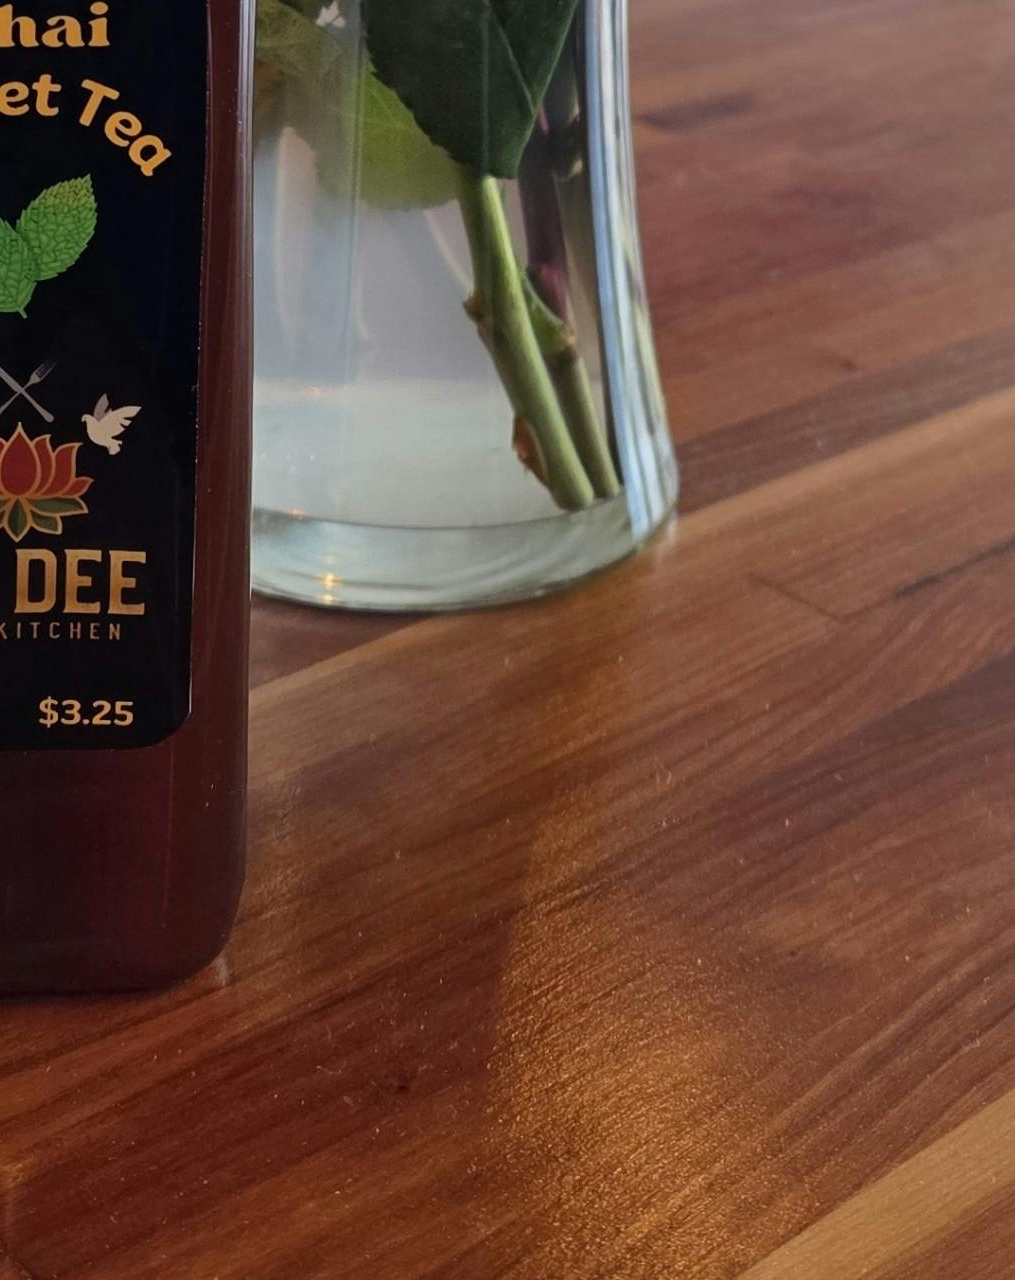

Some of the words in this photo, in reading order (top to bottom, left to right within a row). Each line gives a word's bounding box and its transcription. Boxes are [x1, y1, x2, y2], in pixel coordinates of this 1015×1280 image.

[78, 79, 173, 177] Tea
[14, 548, 147, 615] DEE
[38, 695, 134, 728] $3.25
